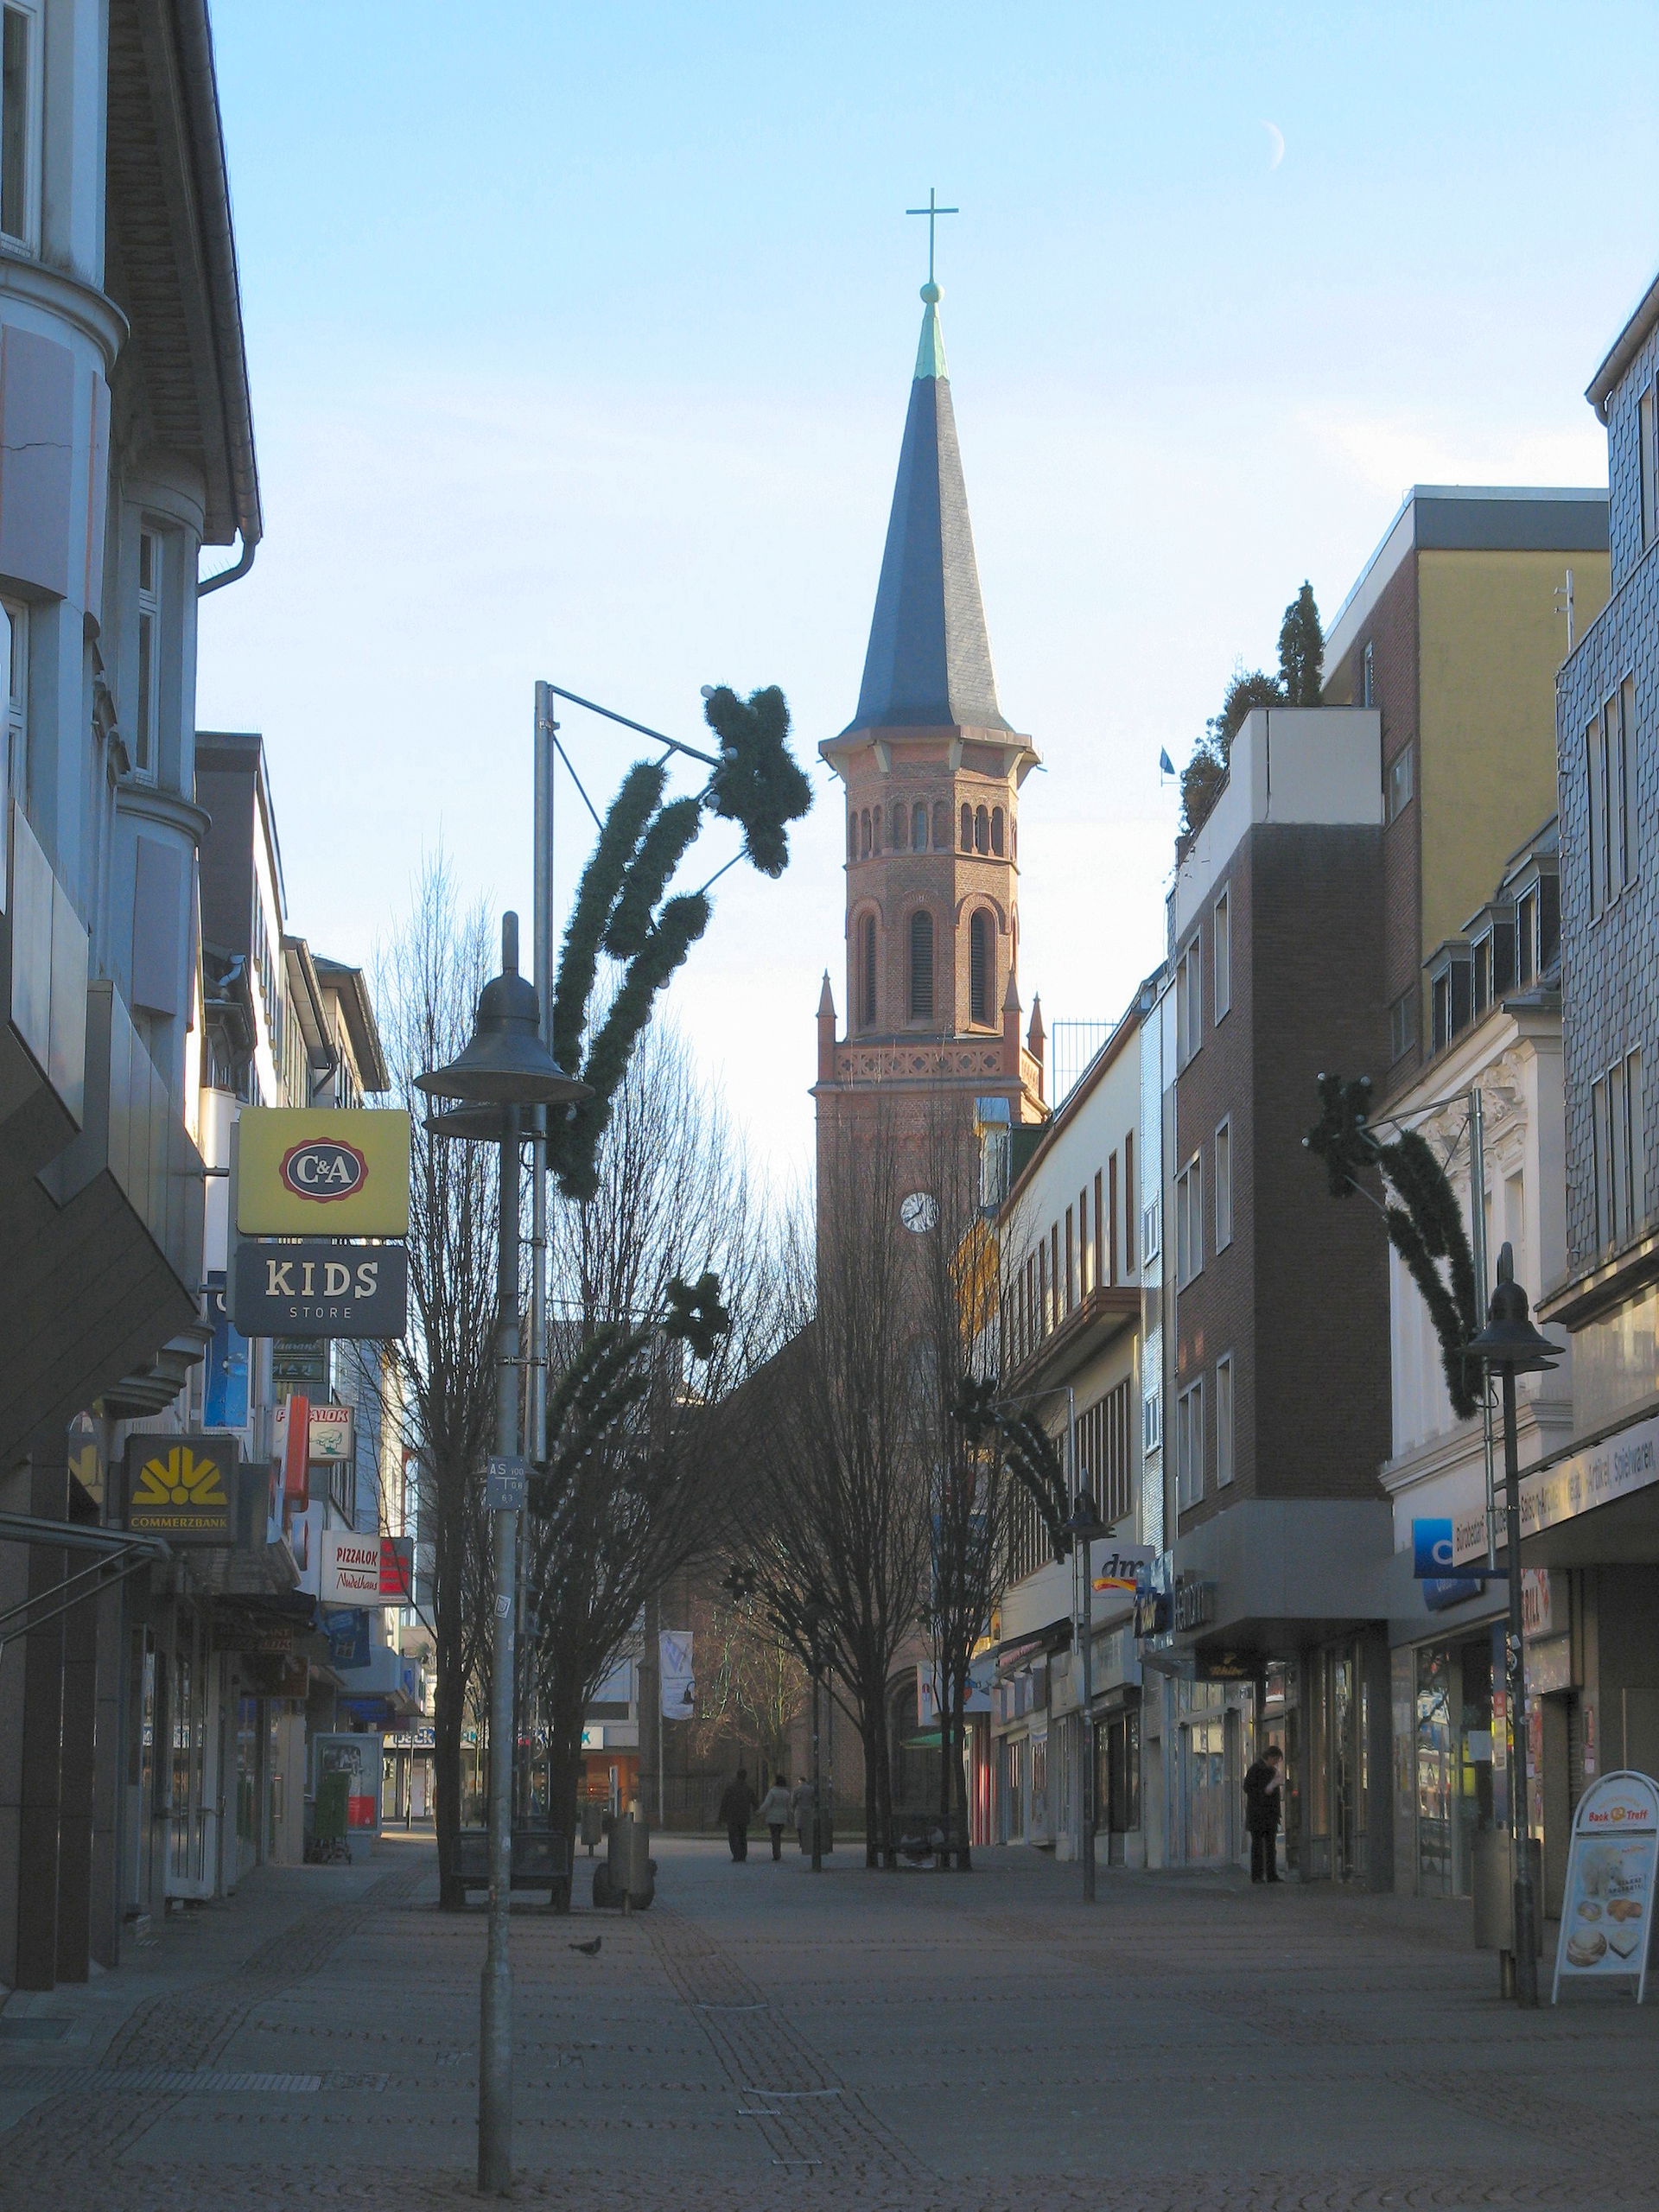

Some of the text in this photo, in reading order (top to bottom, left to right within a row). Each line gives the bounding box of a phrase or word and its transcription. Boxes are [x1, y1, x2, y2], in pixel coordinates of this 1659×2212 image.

[296, 1154, 352, 1184] C&A
[265, 1260, 378, 1299] KIDS
[289, 1306, 352, 1319] STORE
[276, 1408, 348, 1423] PALOK
[490, 1463, 506, 1475] AS
[131, 1517, 227, 1528] COMMERZBANK
[336, 1548, 378, 1567] PIZZALOK
[1102, 1554, 1144, 1578] dm
[336, 1571, 378, 1591] Nudelhaus
[1588, 1809, 1649, 1822] Back Treff
